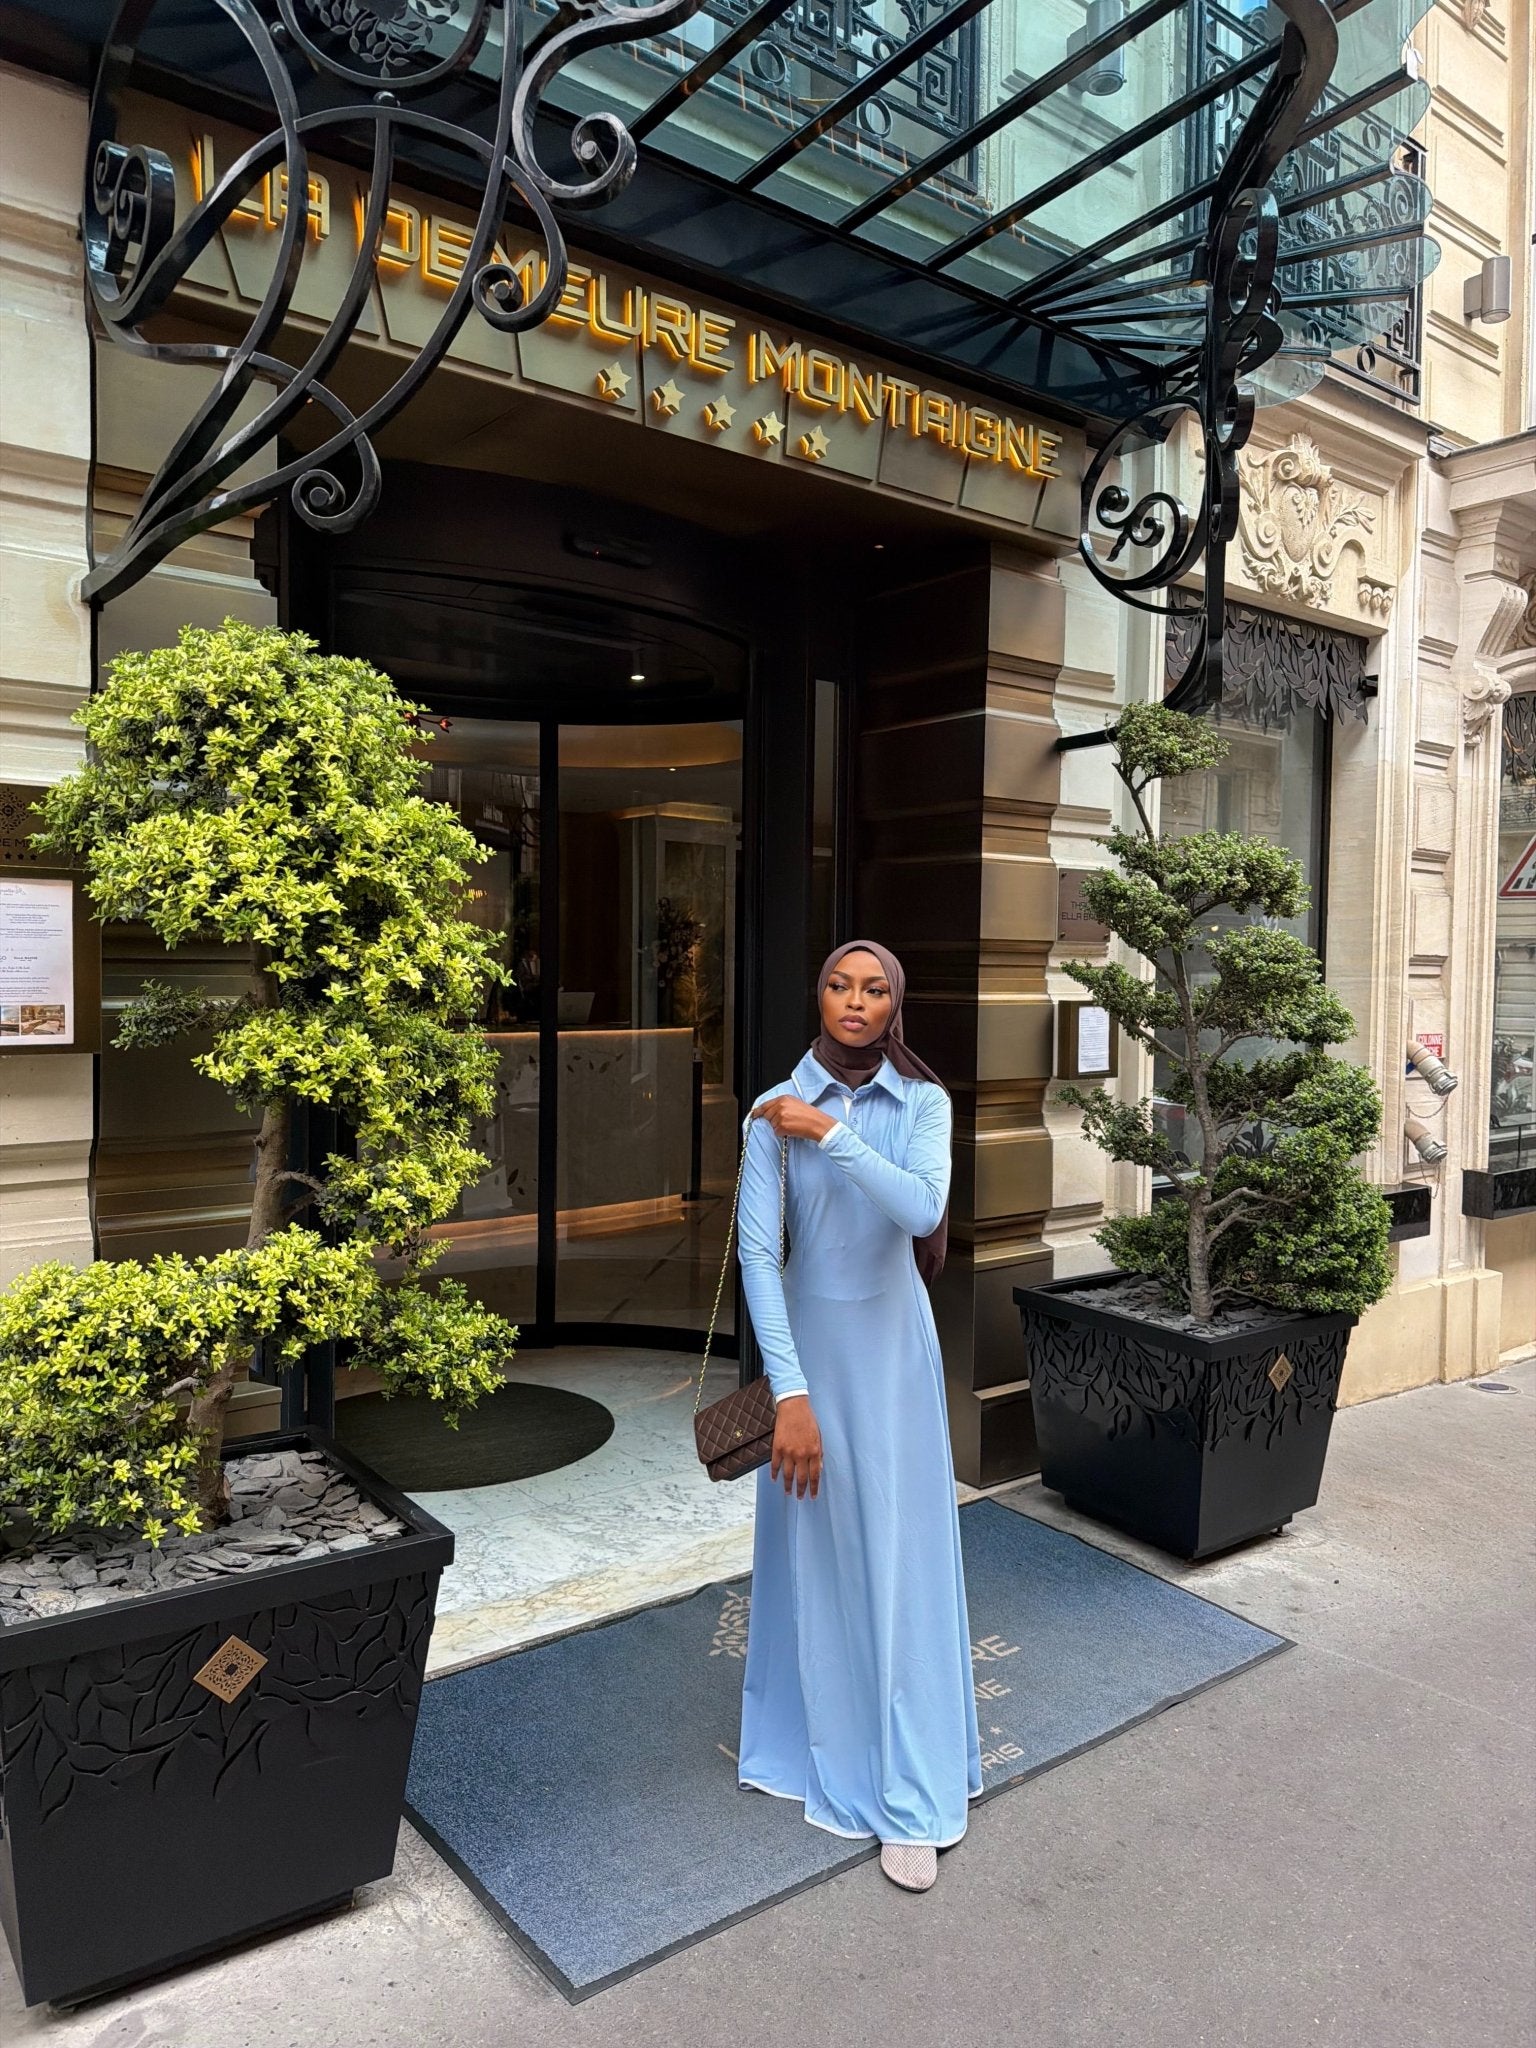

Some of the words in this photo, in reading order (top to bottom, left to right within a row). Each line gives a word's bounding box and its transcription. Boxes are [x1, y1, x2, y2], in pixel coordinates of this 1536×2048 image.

[198, 133, 331, 241] LA
[361, 188, 737, 374] DEMEURE
[749, 328, 1065, 478] MONTAIGNE
[1061, 911, 1082, 921] ELLA
[981, 1742, 1025, 1772] RIS
